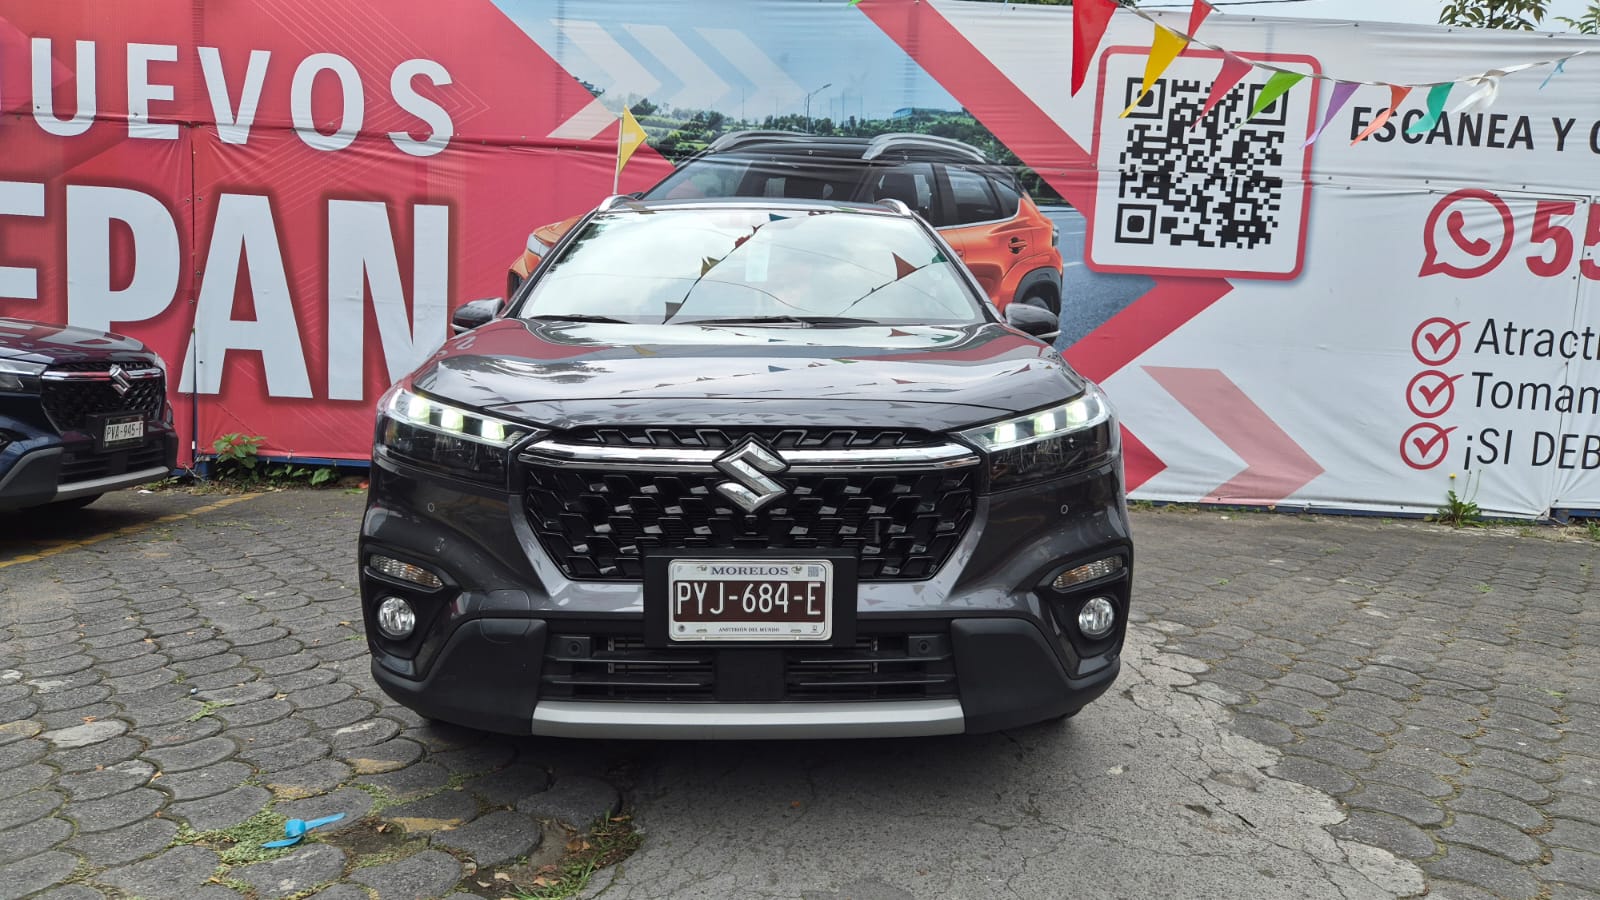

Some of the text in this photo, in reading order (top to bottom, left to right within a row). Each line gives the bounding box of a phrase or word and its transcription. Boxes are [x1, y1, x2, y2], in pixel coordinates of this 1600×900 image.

[1350, 106, 1535, 151] ESCANEA
[1551, 116, 1577, 152] Y
[1463, 427, 1600, 470] ¡SI DEB
[711, 566, 789, 576] MORELOS
[676, 581, 821, 615] PYJ-684-E
